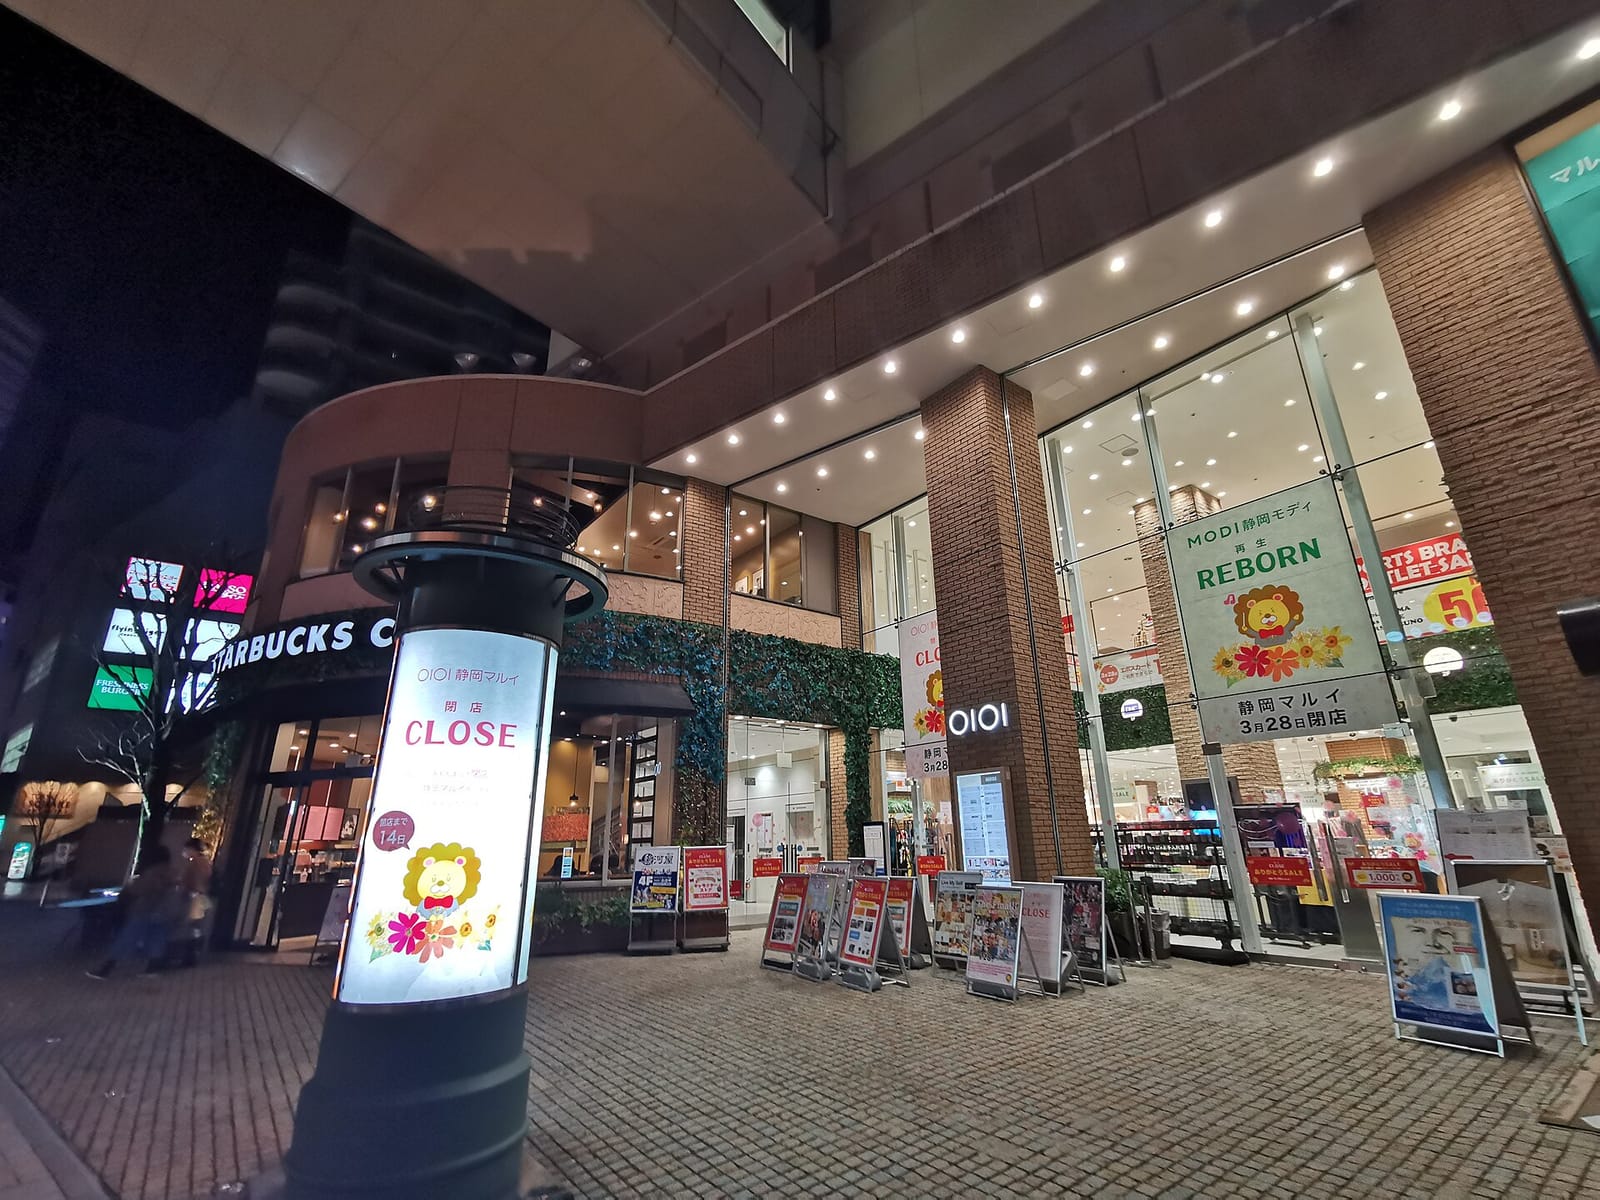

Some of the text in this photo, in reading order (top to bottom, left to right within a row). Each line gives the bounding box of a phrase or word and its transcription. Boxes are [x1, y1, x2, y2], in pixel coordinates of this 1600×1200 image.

[1197, 537, 1322, 590] REBORN
[213, 621, 354, 675] STARBUCKS
[455, 668, 520, 686] 静岡マルイ
[1238, 688, 1341, 716] 静岡マルイ
[405, 719, 517, 748] CLOSE
[1240, 709, 1347, 735] 3月28日閉店
[380, 829, 406, 845] 14日
[638, 875, 653, 886] 4F
